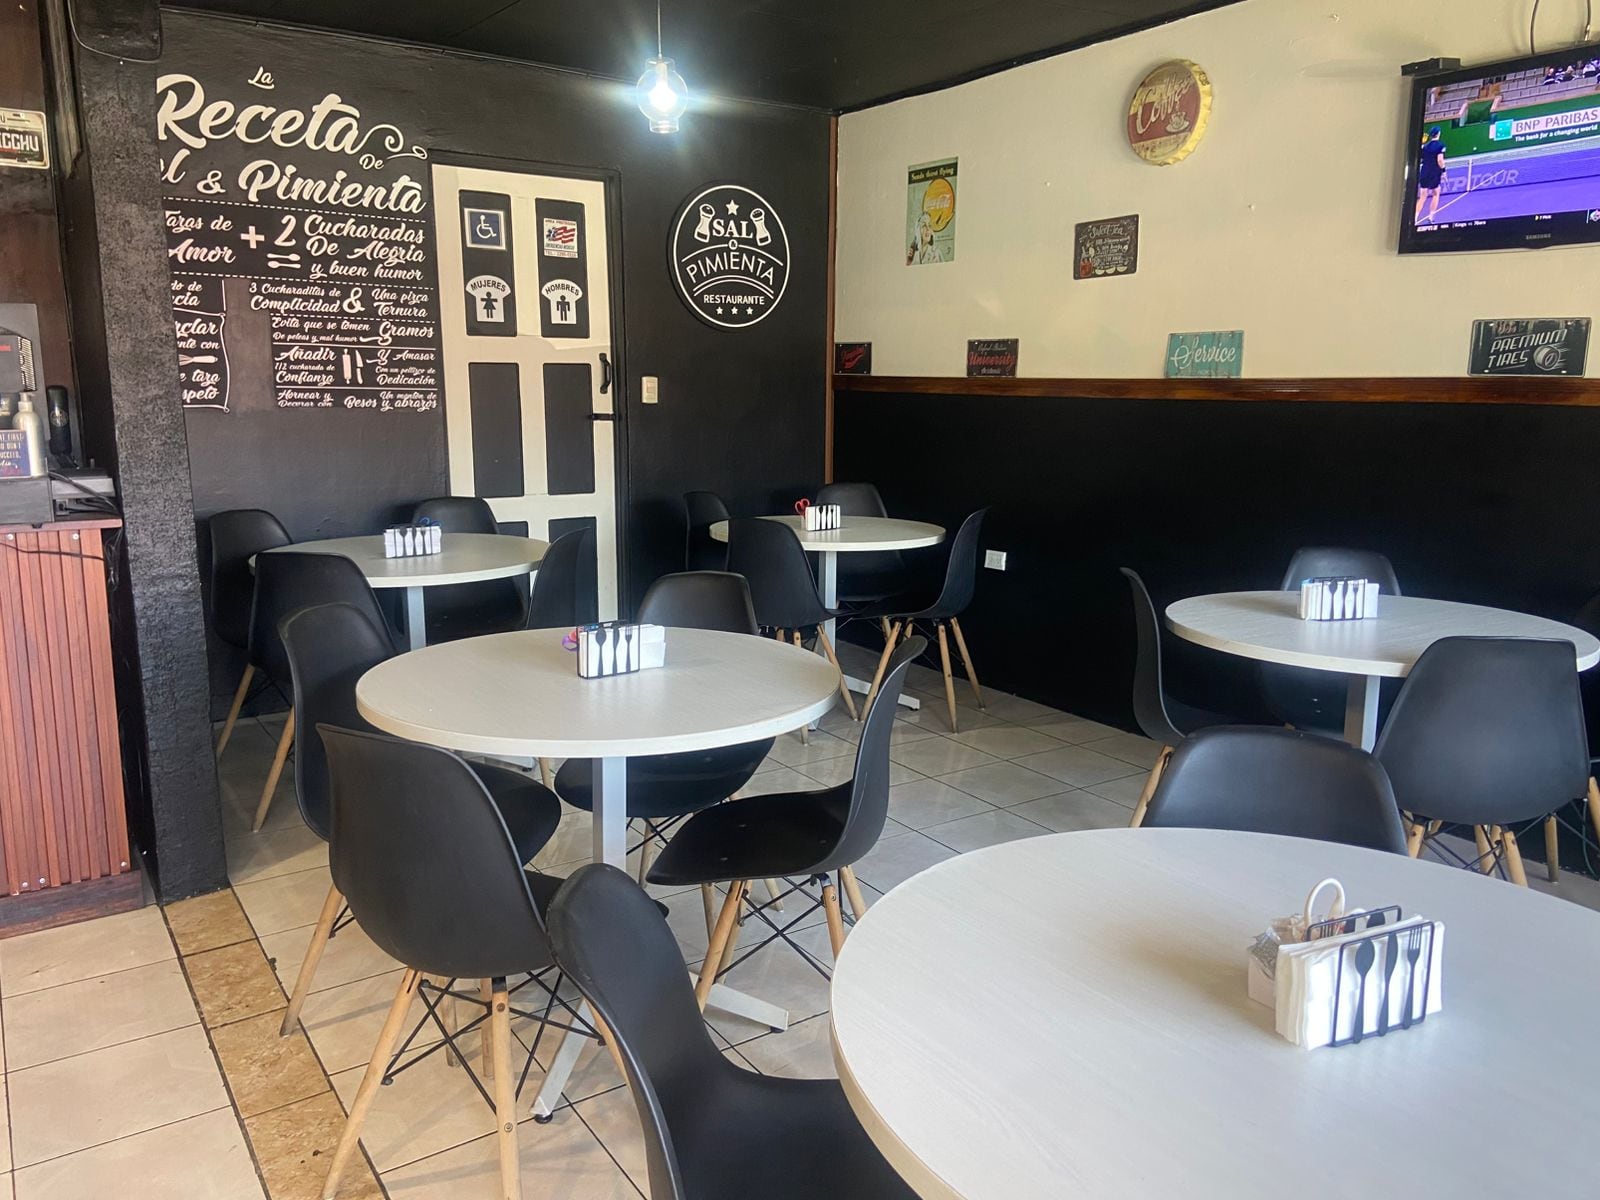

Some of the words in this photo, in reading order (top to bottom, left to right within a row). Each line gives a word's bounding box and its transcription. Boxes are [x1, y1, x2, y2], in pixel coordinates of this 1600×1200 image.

[248, 66, 274, 89] La
[1136, 73, 1191, 134] Coffee
[156, 74, 403, 155] Receta
[1515, 120, 1541, 133] BNP
[1545, 109, 1598, 128] PARIBAS
[1539, 132, 1548, 140] for
[359, 153, 384, 170] De
[197, 170, 226, 194] &
[238, 159, 427, 214] Pimienta
[210, 215, 233, 231] de
[274, 214, 297, 247] 2
[304, 214, 425, 244] Cucharadas
[712, 219, 754, 239] SAL
[168, 238, 236, 264] Amor
[306, 235, 340, 257] De
[309, 263, 328, 280] y
[329, 260, 369, 277] buen
[373, 263, 423, 281] humor
[686, 251, 775, 286] PIMIENTA
[188, 281, 202, 291] de
[249, 282, 257, 293] 3
[261, 283, 325, 297] Cucharaditas
[328, 287, 342, 297] de
[470, 279, 506, 293] MUJERES
[545, 283, 580, 296] HOMBRES
[250, 295, 341, 315] Complicidad
[342, 287, 366, 313] &
[371, 288, 398, 300] Una
[400, 290, 429, 305] pizca
[703, 294, 765, 305] RESTAURANTE
[373, 301, 428, 318] Ternura
[303, 321, 324, 333] que
[326, 322, 338, 330] se
[340, 320, 371, 331] tomen
[360, 321, 435, 346] Gramos
[200, 341, 221, 350] con
[272, 331, 286, 341] De
[287, 333, 310, 342] peleas
[311, 336, 320, 344] y
[334, 335, 358, 343] humor
[1489, 328, 1568, 354] PREMIUM
[274, 345, 337, 362] Añadir
[392, 350, 436, 361] Amasar
[1170, 336, 1236, 370] Service
[1487, 350, 1529, 369] TIRES
[289, 363, 325, 371] cucharada
[375, 366, 389, 374] Con
[191, 369, 221, 387] taza
[275, 370, 336, 387] Confianza
[376, 374, 436, 386] Dedicación
[277, 389, 322, 401] Hornear
[322, 392, 334, 403] y
[277, 399, 315, 408] Decorar
[344, 395, 377, 409] Besos
[379, 391, 394, 400] Un
[426, 392, 437, 400] de
[380, 400, 394, 413] y
[394, 397, 437, 413] abrazos
